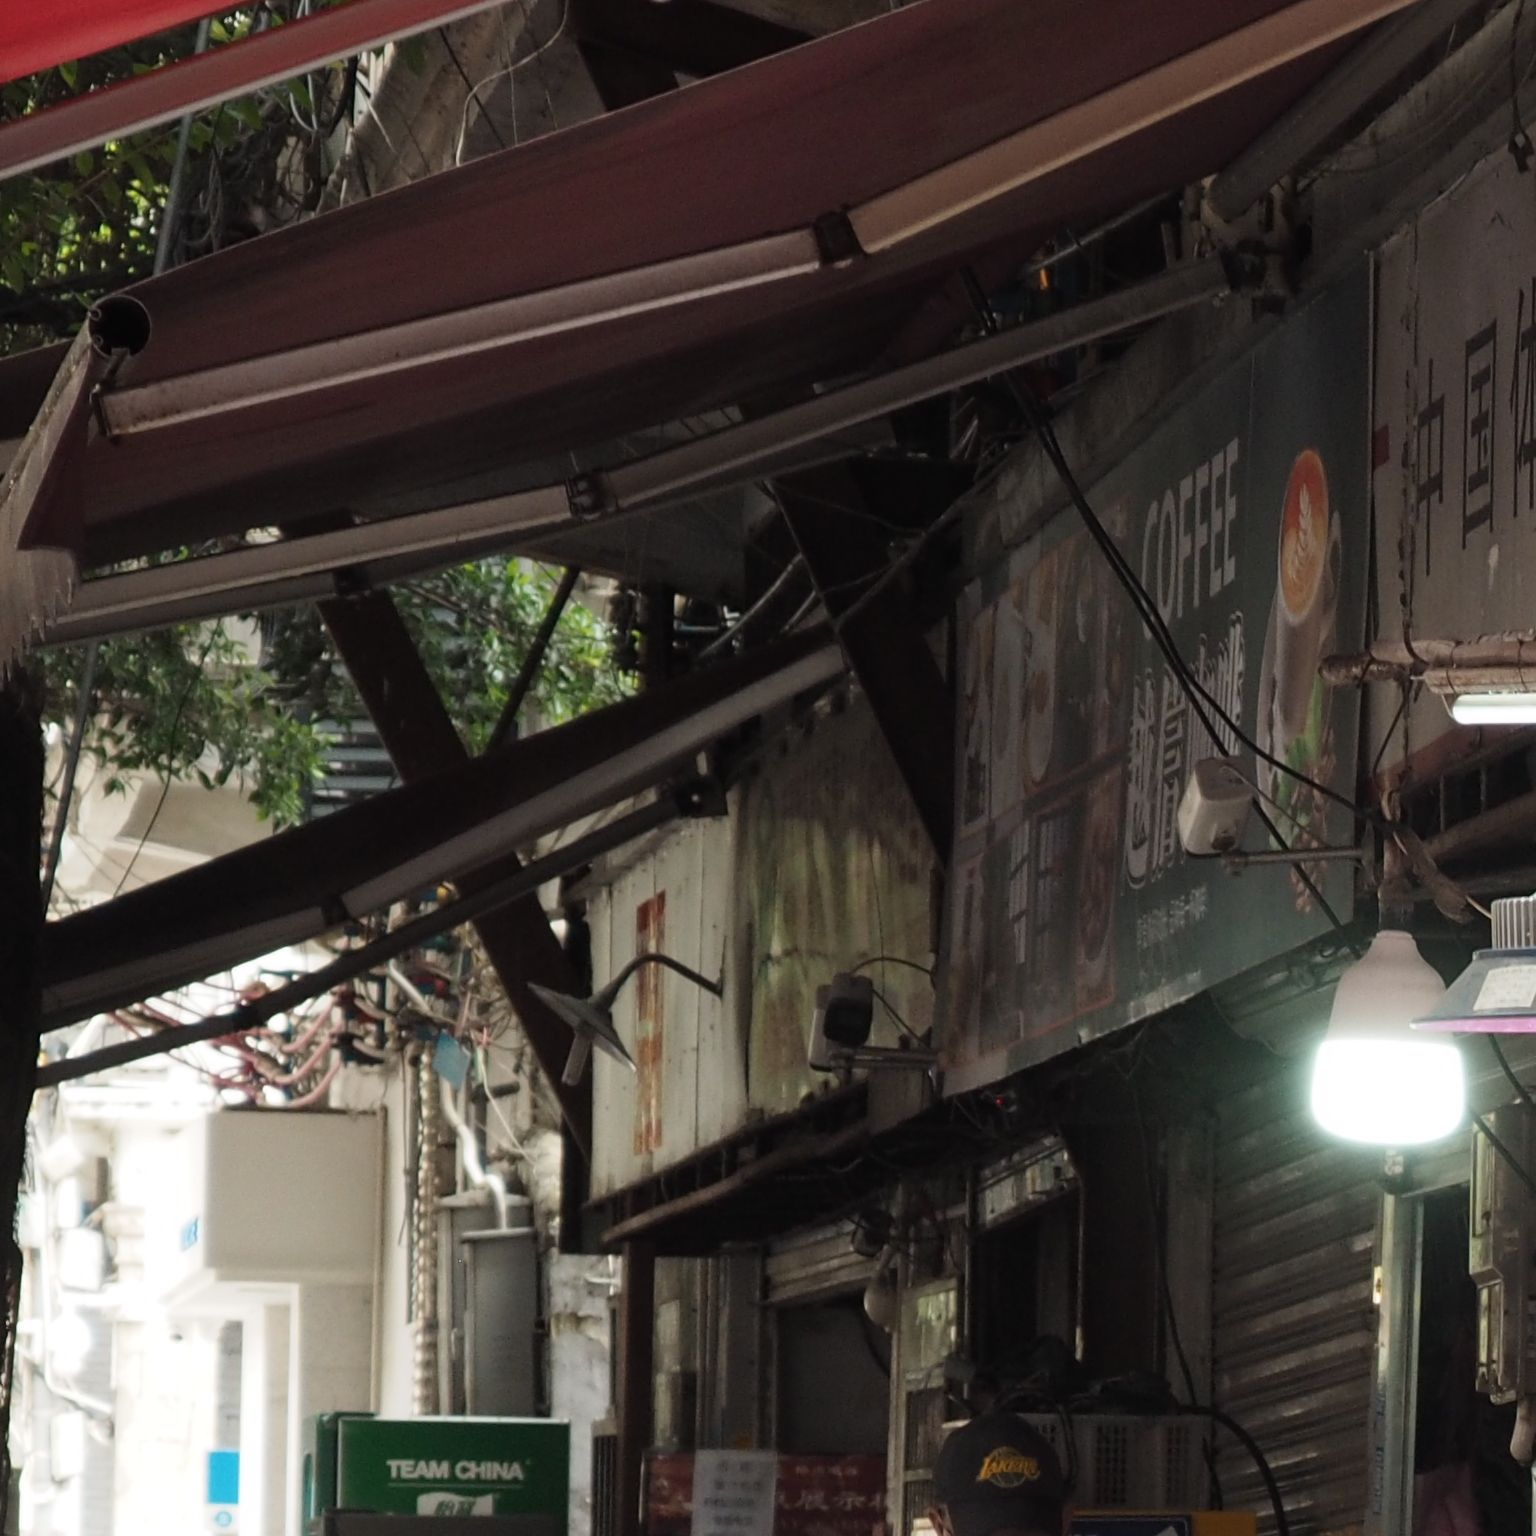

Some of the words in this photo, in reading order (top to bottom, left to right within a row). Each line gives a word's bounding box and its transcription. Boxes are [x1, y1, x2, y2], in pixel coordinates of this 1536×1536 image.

[1141, 437, 1239, 640] COFFEE
[386, 1459, 449, 1481] TEAM
[455, 1460, 525, 1482] CHINA
